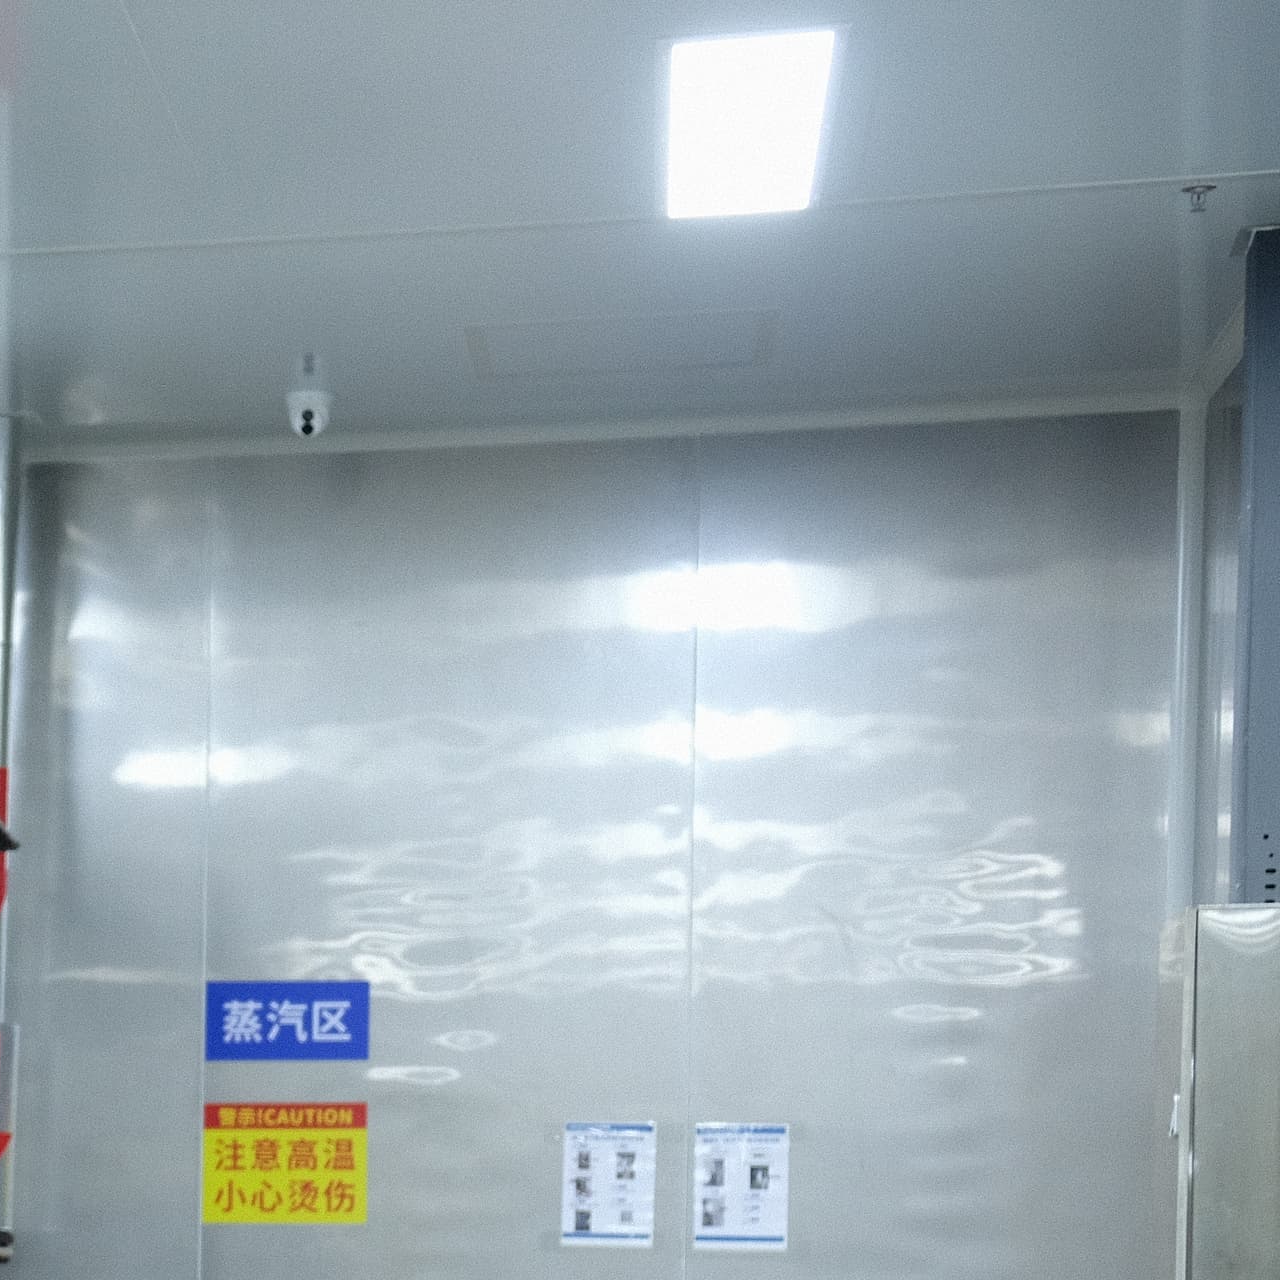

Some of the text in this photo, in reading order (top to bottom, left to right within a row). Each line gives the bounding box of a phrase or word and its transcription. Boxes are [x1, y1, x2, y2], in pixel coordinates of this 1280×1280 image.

[222, 1000, 351, 1043] 蒸汽区
[215, 1138, 356, 1171] 注意高温
[215, 1180, 356, 1213] 小心烫伤
